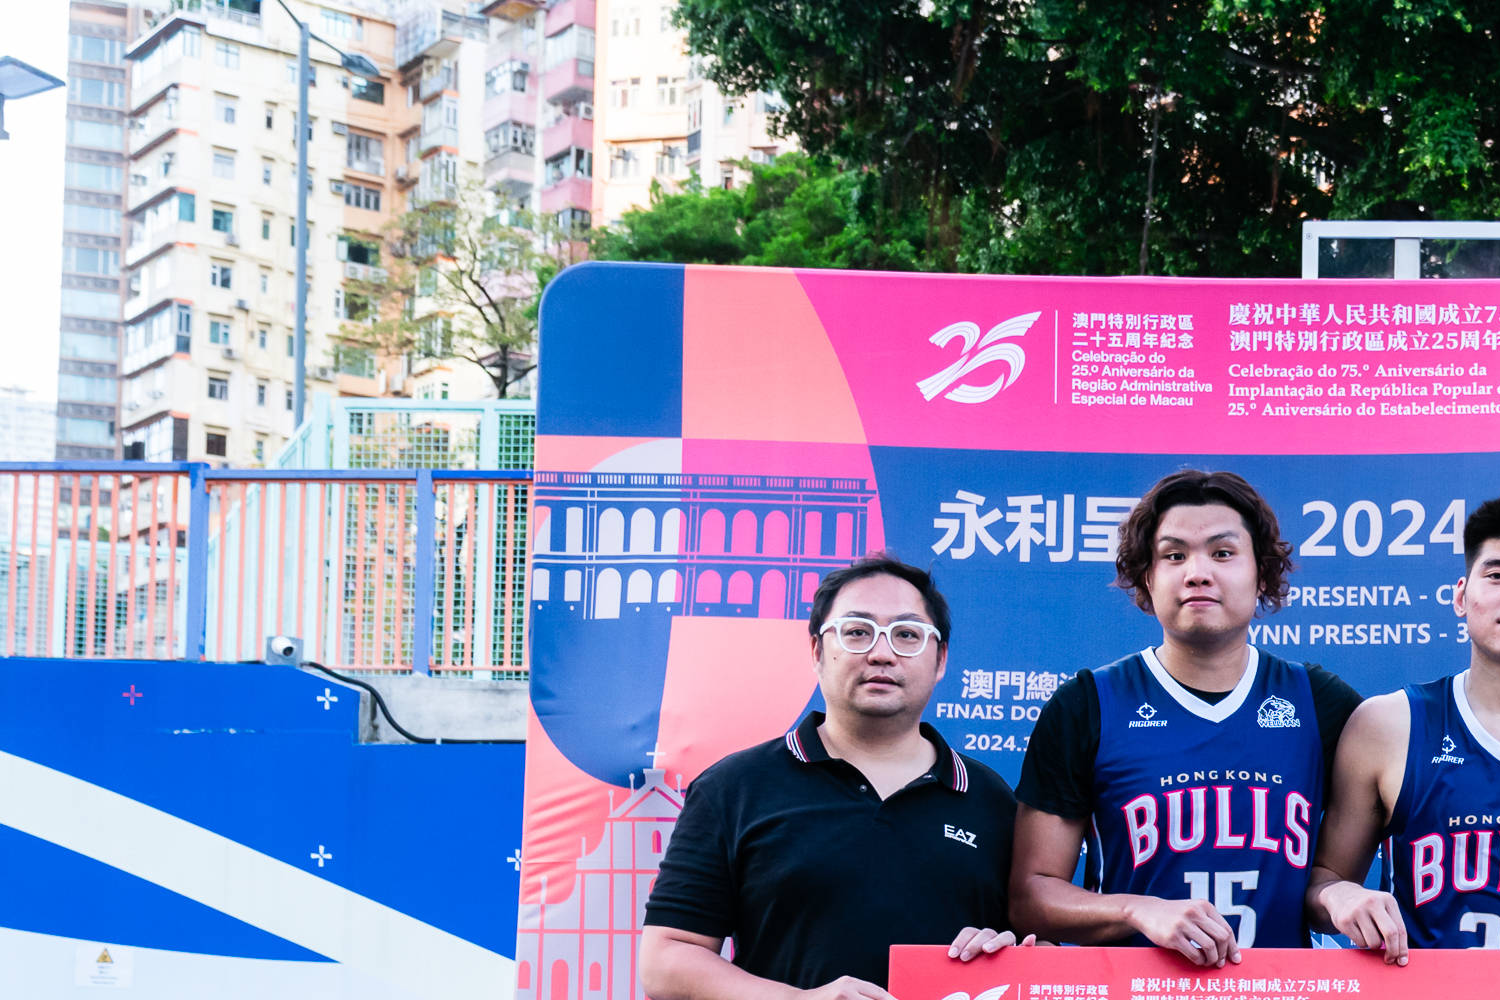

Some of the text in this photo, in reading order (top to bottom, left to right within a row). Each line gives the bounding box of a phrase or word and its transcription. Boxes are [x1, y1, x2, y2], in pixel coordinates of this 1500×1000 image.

[1073, 312, 1193, 330] 澳門特別行政區
[1072, 331, 1193, 348] 二十五周年紀念
[1072, 350, 1145, 365] Celebração
[1072, 364, 1175, 377] 25.º Aniversário
[1229, 363, 1464, 380] Celebração 75.º Aniversário
[1072, 379, 1212, 394] Região Administrativa
[1229, 383, 1323, 399] Implantação
[1351, 383, 1427, 398] República
[1433, 382, 1493, 398] Popular
[1072, 393, 1193, 406] Especial Macau
[1228, 402, 1256, 415] 25.º
[1262, 399, 1352, 416] Aniversário
[1287, 585, 1411, 607] PRESENTA
[1247, 624, 1300, 645] YNN
[1309, 623, 1431, 645] PRESENTS
[961, 669, 1078, 701] 澳門總
[936, 703, 1004, 720] FINAIS
[1129, 720, 1168, 728] RIGORER
[1160, 770, 1282, 786] HONG KONG
[944, 824, 977, 843] EA7
[1121, 785, 1312, 871] BULLS
[1030, 985, 1108, 995] 澳門特別行政區
[1131, 978, 1360, 992] 慶祝中華人民共和國成立75周年及
